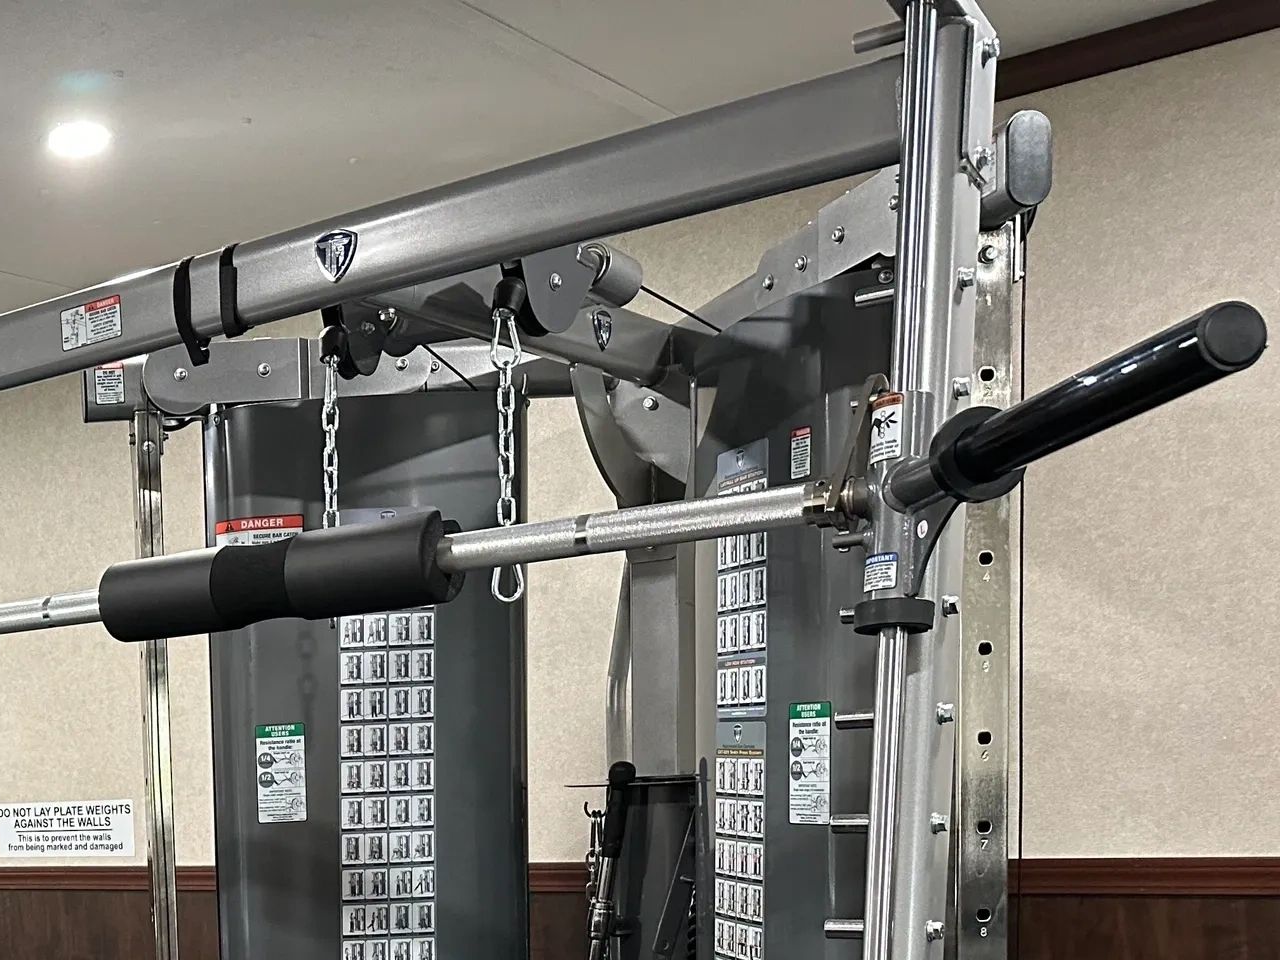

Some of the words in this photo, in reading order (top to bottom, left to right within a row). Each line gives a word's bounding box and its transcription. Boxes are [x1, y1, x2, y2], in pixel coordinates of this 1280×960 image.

[241, 519, 283, 529] DANGER
[920, 524, 926, 534] L
[983, 570, 990, 582] 4
[981, 750, 989, 761] 6
[13, 808, 31, 817] NOT
[34, 807, 51, 817] LAY
[54, 806, 83, 816] PLATE
[86, 804, 131, 815] WEIGHTS
[14, 818, 54, 828] AGAINST
[57, 818, 75, 827] THE
[78, 817, 111, 827] WALLS
[51, 835, 78, 843] prevent
[981, 838, 988, 849] 7
[26, 843, 45, 852] being
[47, 843, 72, 851] marked
[90, 842, 123, 852] damaged
[980, 927, 988, 937] 8
